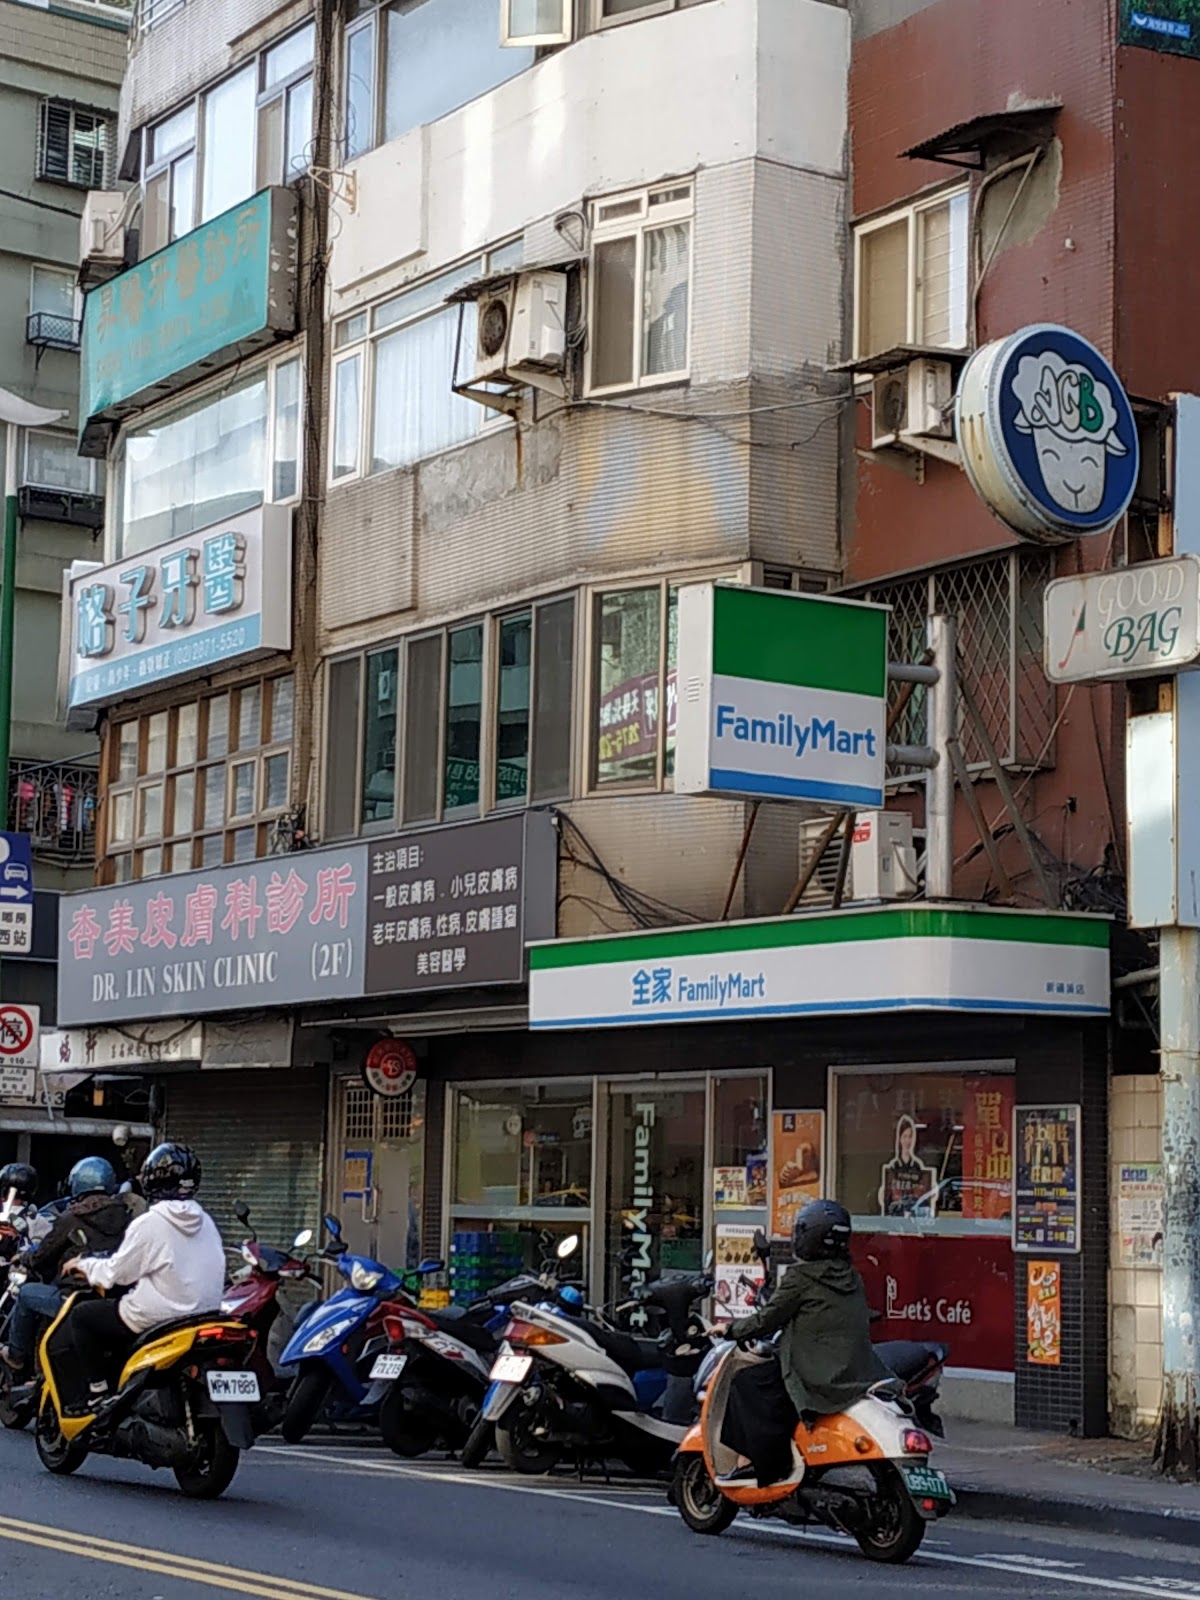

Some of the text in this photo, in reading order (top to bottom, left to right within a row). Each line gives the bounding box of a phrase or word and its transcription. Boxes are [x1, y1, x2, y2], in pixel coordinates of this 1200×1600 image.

[77, 532, 244, 658] 格子牙醫
[1097, 563, 1185, 629] GOOD
[1104, 605, 1183, 664] BAG
[716, 705, 876, 757] FamilyMart
[68, 862, 357, 960] 杏美皮膚科診所
[92, 937, 353, 1003] DR. LIN SKIN CLINIC (2F)
[416, 947, 467, 975] 美容醫學
[631, 967, 765, 1006] 全家 FamilyMart
[0, 1017, 23, 1044] 停
[886, 1274, 971, 1325] Let's Café
